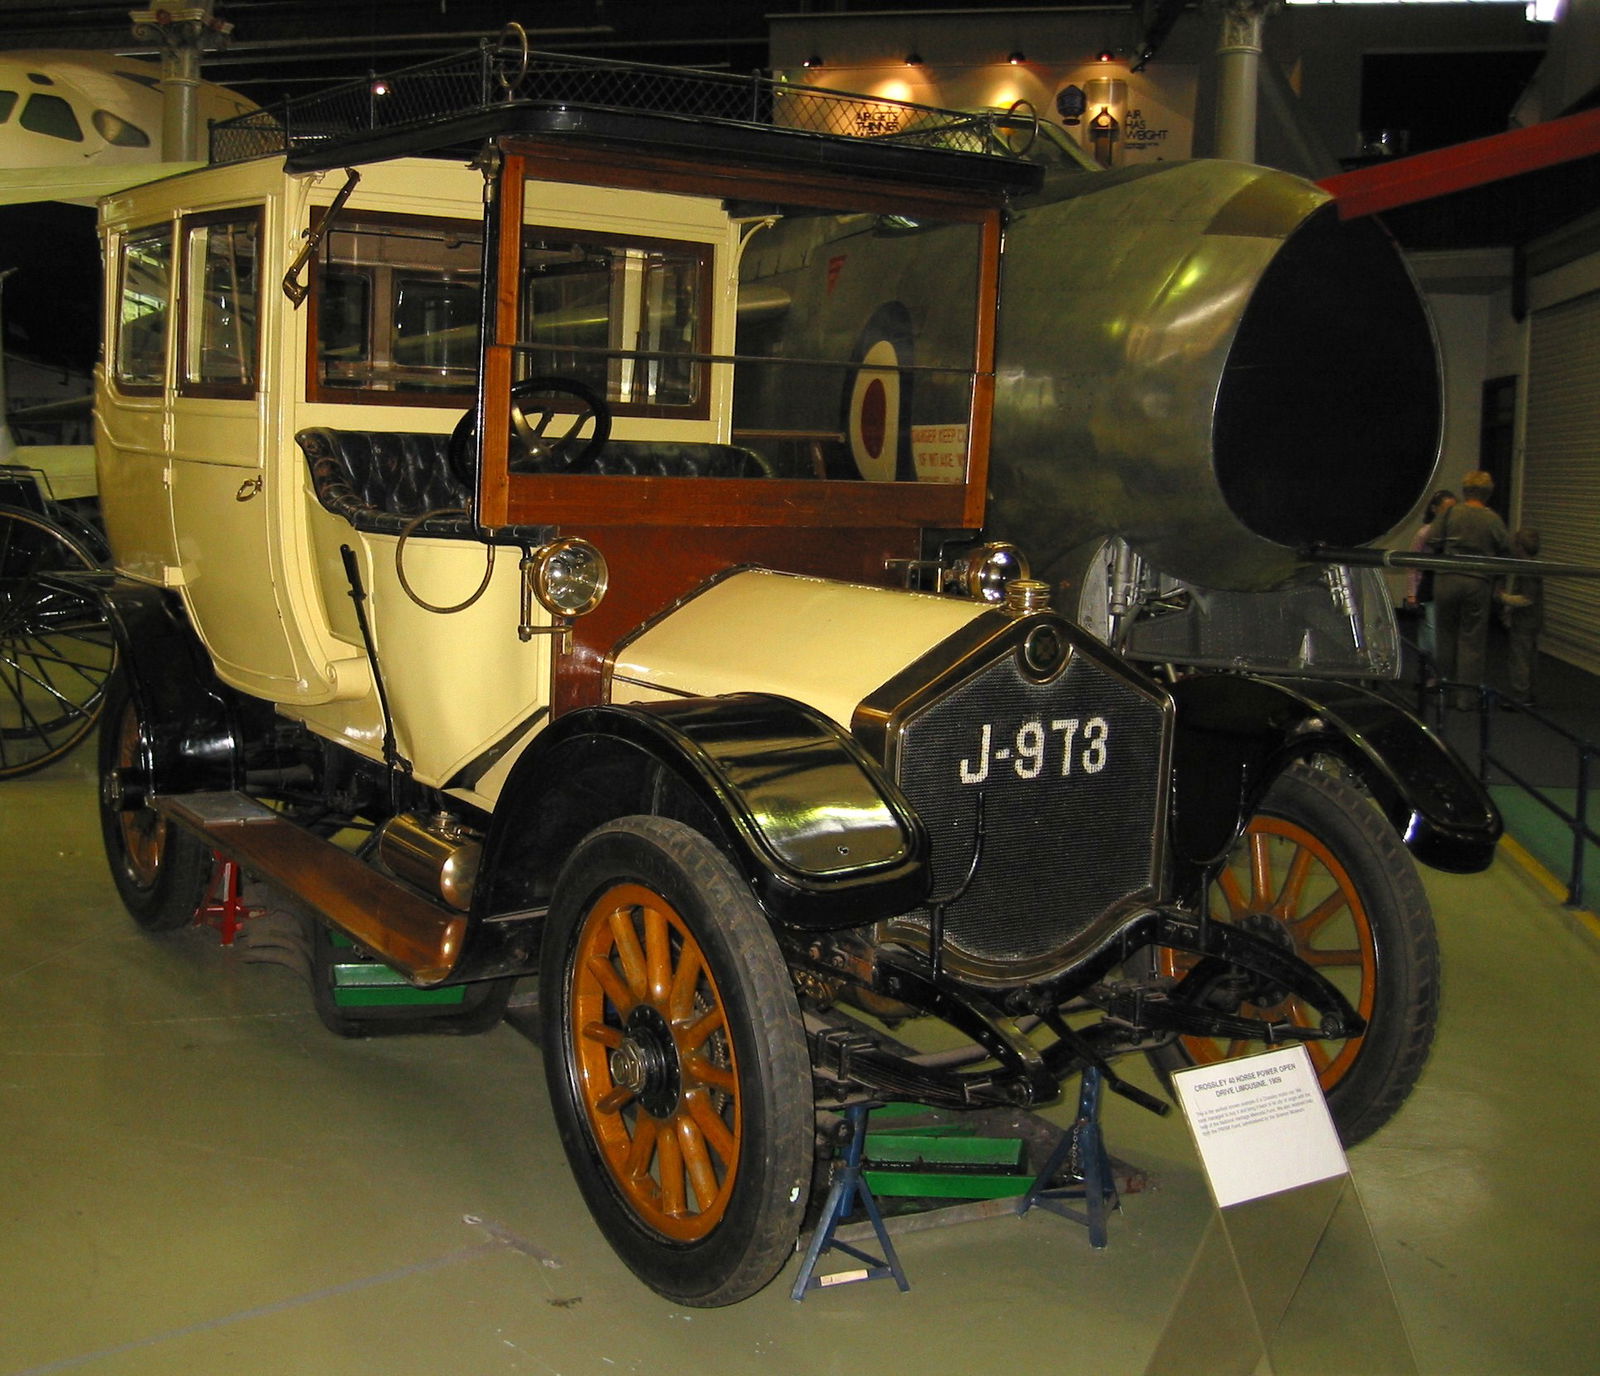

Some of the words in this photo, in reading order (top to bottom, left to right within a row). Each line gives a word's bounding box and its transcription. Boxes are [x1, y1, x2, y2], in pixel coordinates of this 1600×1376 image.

[1126, 110, 1141, 119] AIR
[960, 716, 1109, 785] J-973
[1194, 1079, 1227, 1092] CROSSLEY
[1236, 1072, 1256, 1083] HORSE
[1256, 1066, 1279, 1078] POWER
[1279, 1063, 1296, 1073] OPEN
[1215, 1087, 1235, 1097] DRIVE
